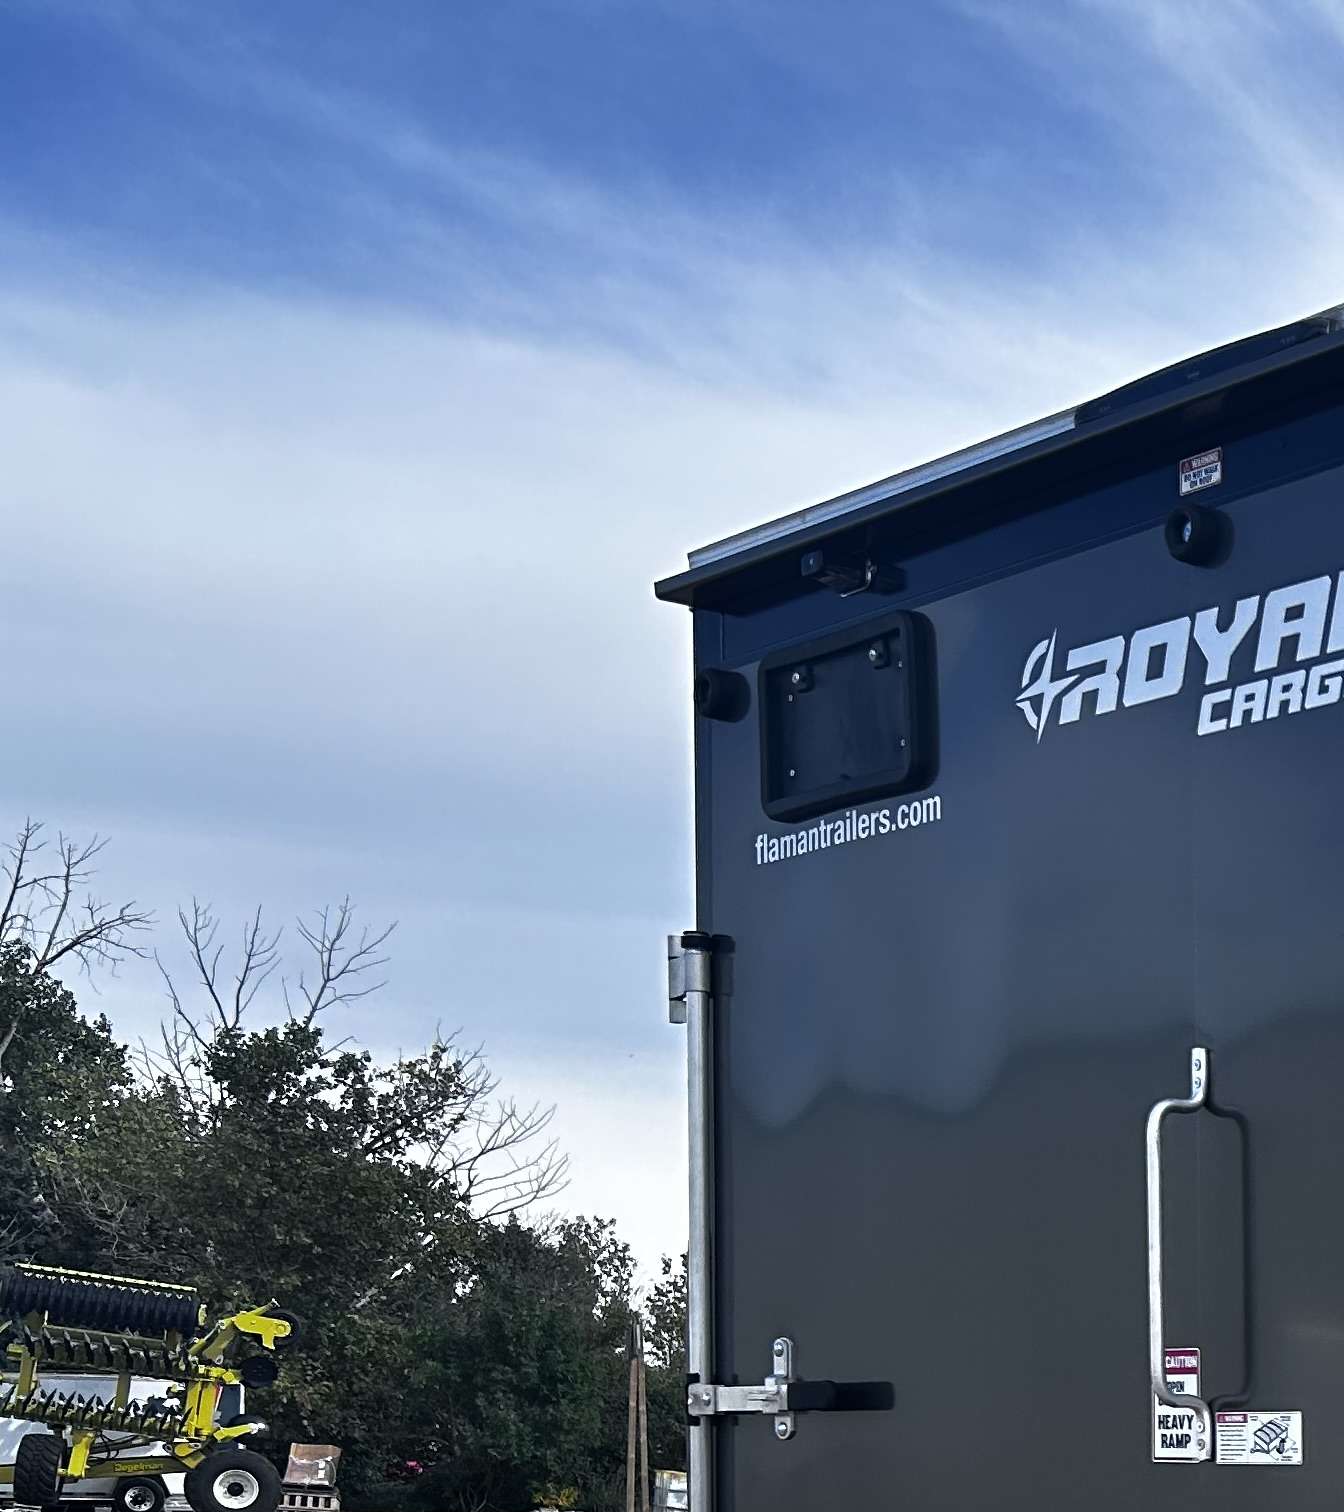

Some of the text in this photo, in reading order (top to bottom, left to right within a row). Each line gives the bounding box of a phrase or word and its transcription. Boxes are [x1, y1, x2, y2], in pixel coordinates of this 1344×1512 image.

[755, 795, 942, 865] flamantrailers.com
[1158, 1414, 1195, 1430] HEAVY
[1161, 1434, 1192, 1449] RAMP
